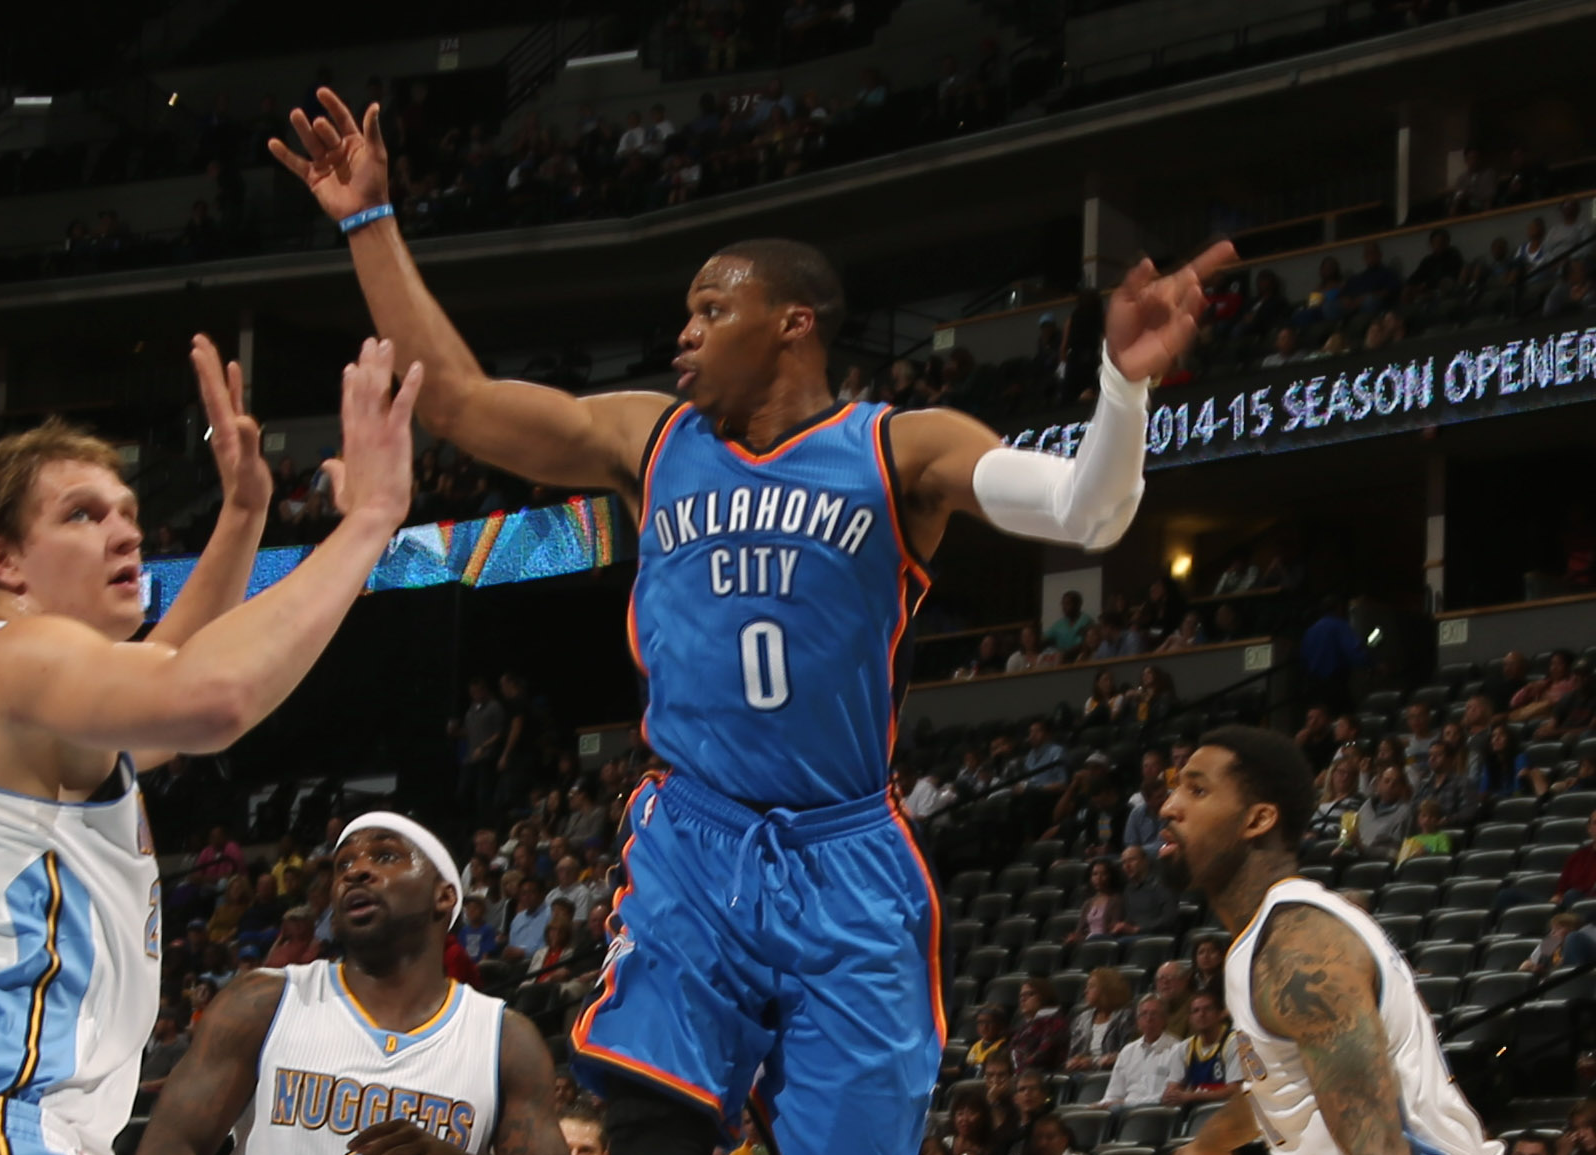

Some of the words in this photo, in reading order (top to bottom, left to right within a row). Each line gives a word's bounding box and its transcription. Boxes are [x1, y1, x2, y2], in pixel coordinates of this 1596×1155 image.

[1145, 384, 1273, 454] 014-15
[1280, 355, 1435, 433] SEASON
[654, 486, 875, 556] OKLAHOMA
[710, 546, 800, 596] CITY
[739, 619, 793, 713] 0
[271, 1067, 476, 1151] NUGGETS
